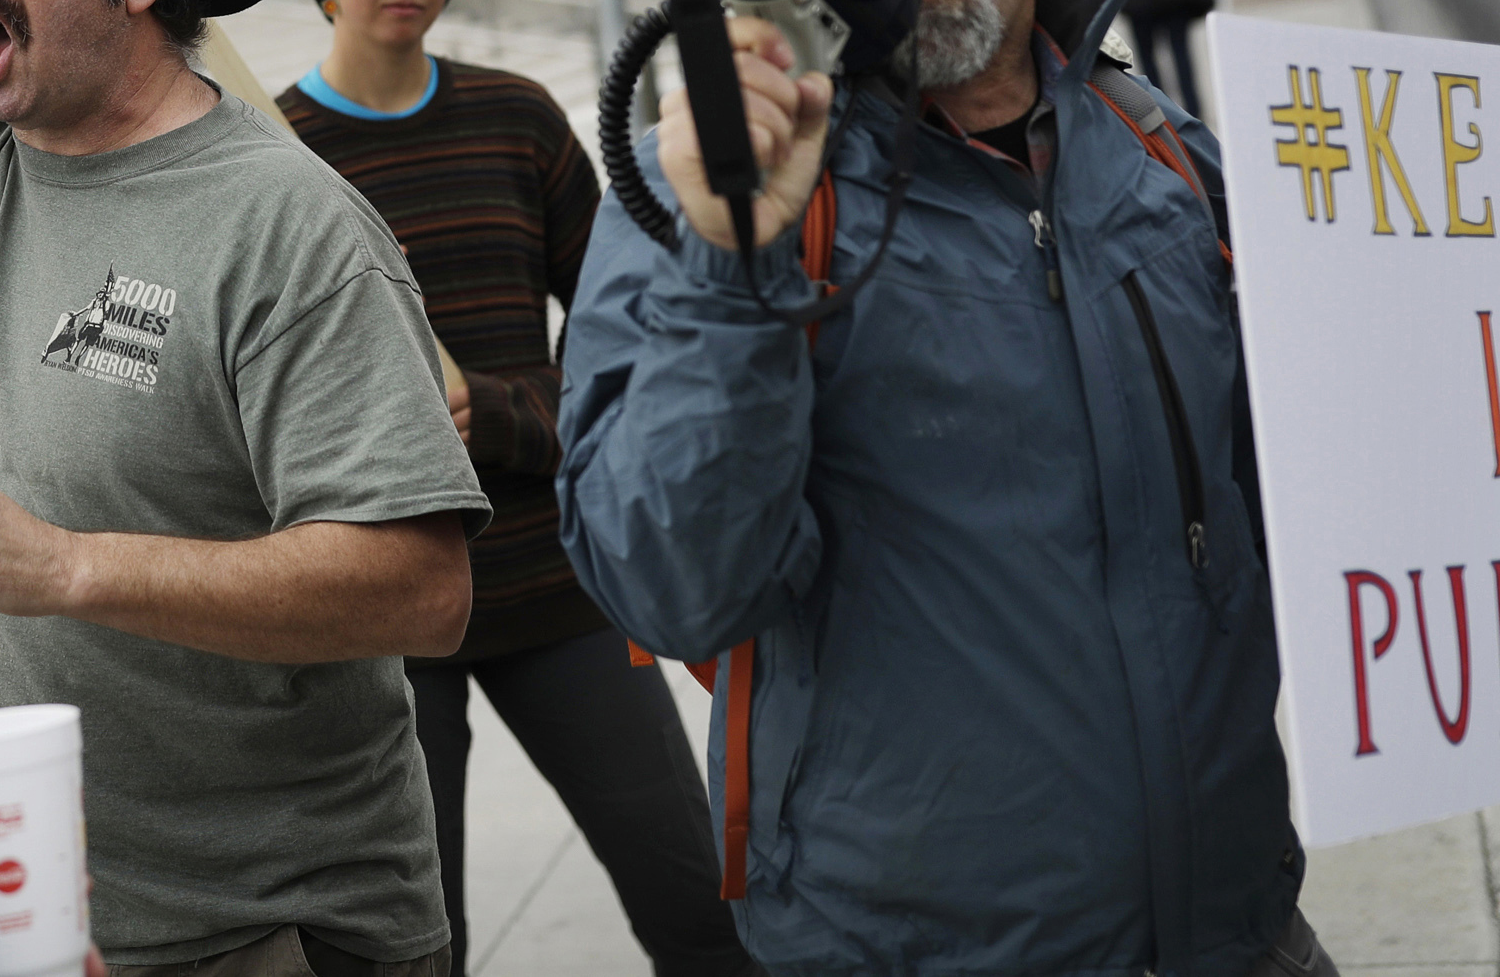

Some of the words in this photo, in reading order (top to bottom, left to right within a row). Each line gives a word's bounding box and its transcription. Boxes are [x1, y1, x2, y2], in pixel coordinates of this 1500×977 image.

[111, 275, 177, 317] 5000
[102, 322, 164, 349] DISCOVERING
[106, 303, 171, 336] MILES
[82, 348, 160, 385] HEROES
[94, 336, 160, 365] AMERICA'S
[77, 367, 95, 378] PTSD
[95, 372, 134, 389] AWARENESS
[135, 382, 155, 394] WALK
[1342, 559, 1500, 758] PU
